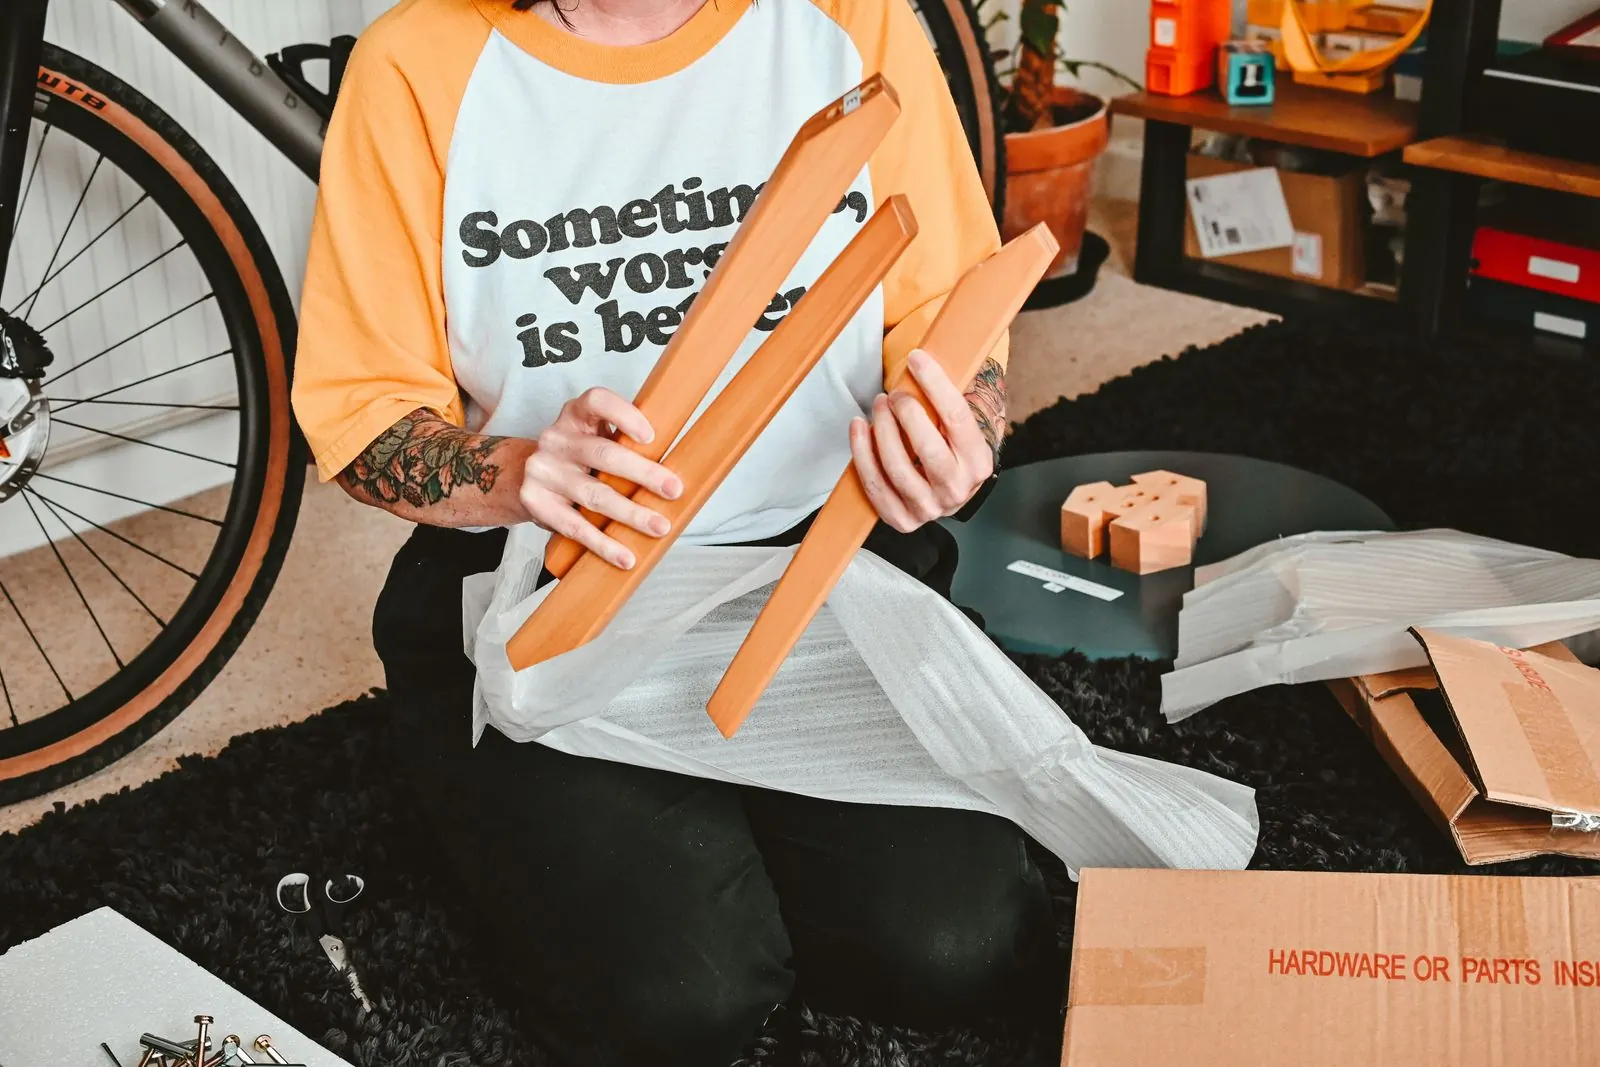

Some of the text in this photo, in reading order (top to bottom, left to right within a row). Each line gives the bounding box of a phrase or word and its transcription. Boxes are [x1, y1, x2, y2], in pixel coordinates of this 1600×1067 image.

[459, 176, 868, 268] Sometim,
[515, 313, 582, 368] is
[1268, 949, 1406, 980] HARDWARE
[1413, 955, 1451, 982] OR
[1461, 957, 1542, 986] PARTS
